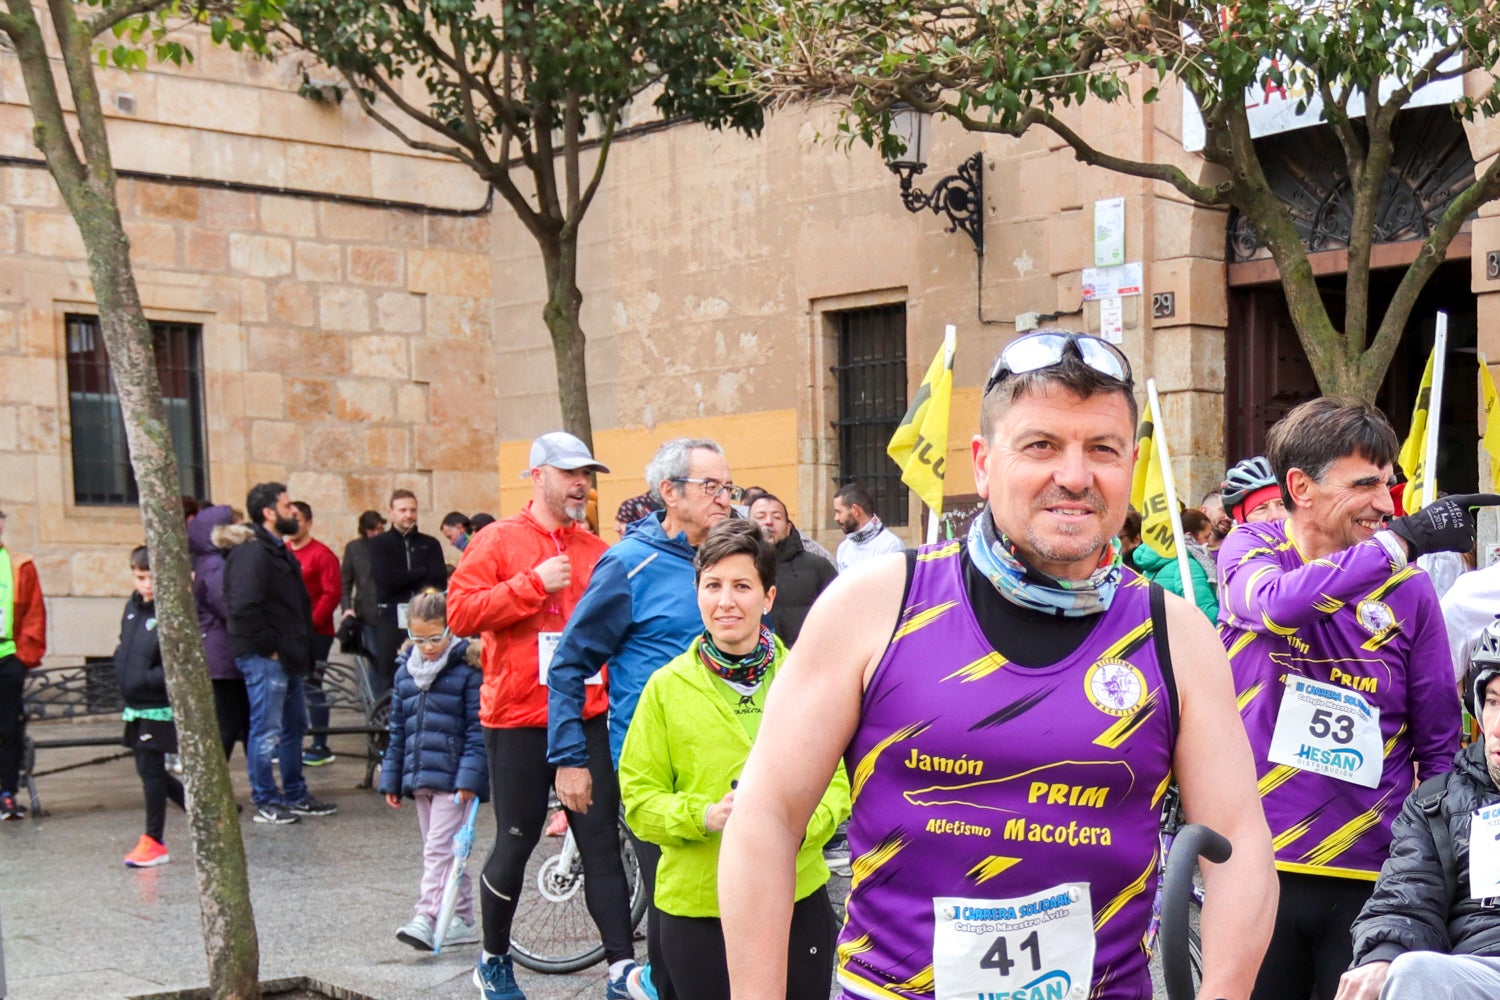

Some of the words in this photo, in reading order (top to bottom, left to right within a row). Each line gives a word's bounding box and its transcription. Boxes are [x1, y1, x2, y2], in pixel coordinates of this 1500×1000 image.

[1153, 293, 1171, 316] 29
[1330, 668, 1377, 693] PRIM
[1309, 708, 1355, 744] 53
[904, 748, 984, 776] Jamón
[1299, 744, 1356, 771] HESAN
[1028, 782, 1110, 808] PRIM
[926, 819, 991, 838] Atletismo
[1004, 818, 1111, 846] Macotera
[955, 922, 994, 934] Colegio
[996, 917, 1040, 931] Maestro
[1042, 908, 1070, 922] Ávila
[963, 906, 1017, 921] CARRERA
[980, 930, 1041, 976] 41
